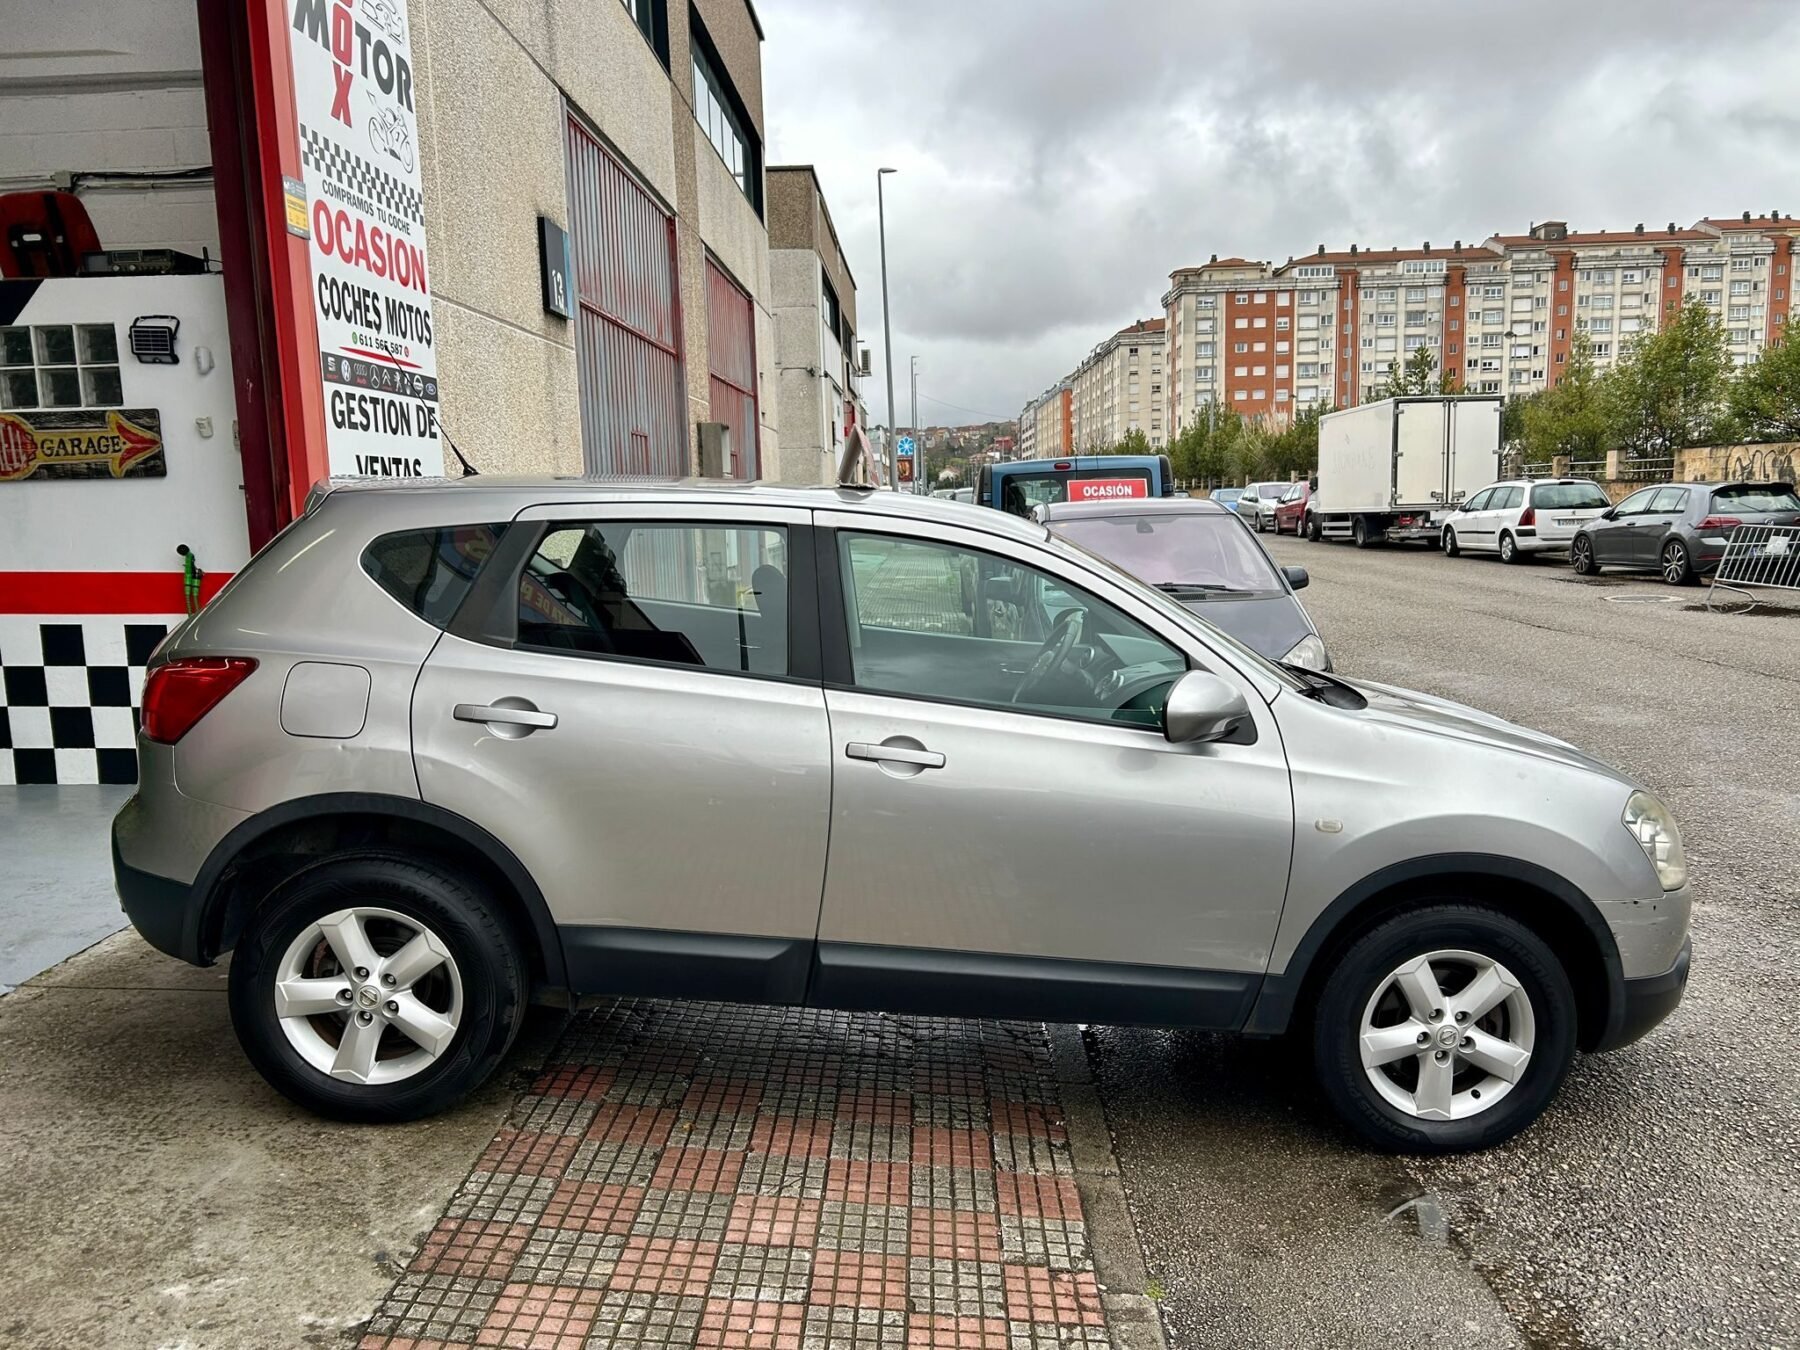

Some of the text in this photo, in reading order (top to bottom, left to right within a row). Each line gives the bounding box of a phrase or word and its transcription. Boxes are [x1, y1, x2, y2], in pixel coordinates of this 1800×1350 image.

[331, 0, 353, 128] OX
[322, 179, 374, 217] COMPRAMOS
[377, 207, 387, 223] TU
[388, 213, 411, 236] COCHE
[313, 199, 427, 294] OCASION
[318, 273, 432, 348] COCHES MOTOS
[552, 269, 565, 311] 13
[359, 334, 373, 348] 611
[331, 389, 438, 440] GESTION DE
[40, 435, 122, 458] GARAGE
[1083, 482, 1133, 497] OCASIÓN
